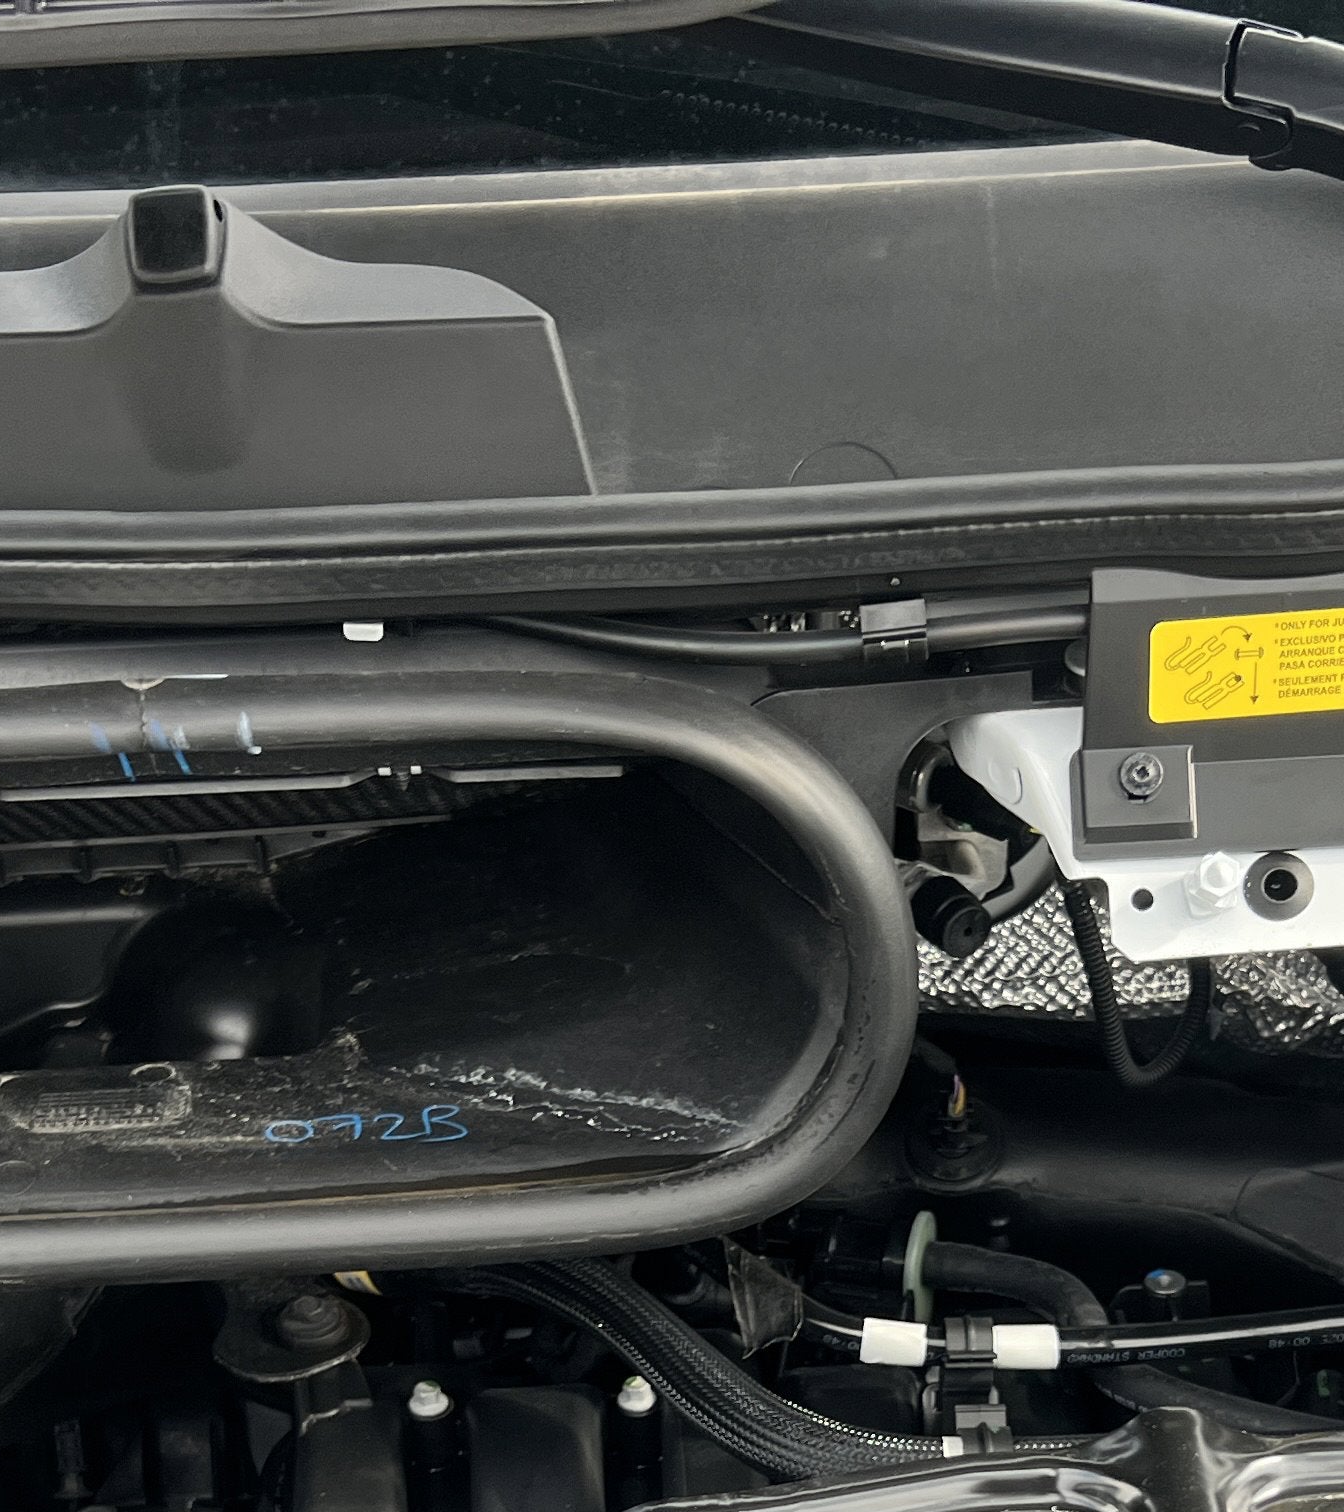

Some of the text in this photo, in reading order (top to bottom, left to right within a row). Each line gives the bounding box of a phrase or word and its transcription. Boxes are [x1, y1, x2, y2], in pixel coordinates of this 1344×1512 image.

[1280, 620, 1307, 631] ONLY
[1309, 618, 1330, 629] FOR
[1279, 634, 1336, 647] EXCLUSIVO
[1279, 646, 1335, 659] ARRANQUE
[1279, 660, 1306, 671] PASA
[1278, 674, 1338, 687] SEULEMENT
[1278, 684, 1341, 699] DÉMARRAGE
